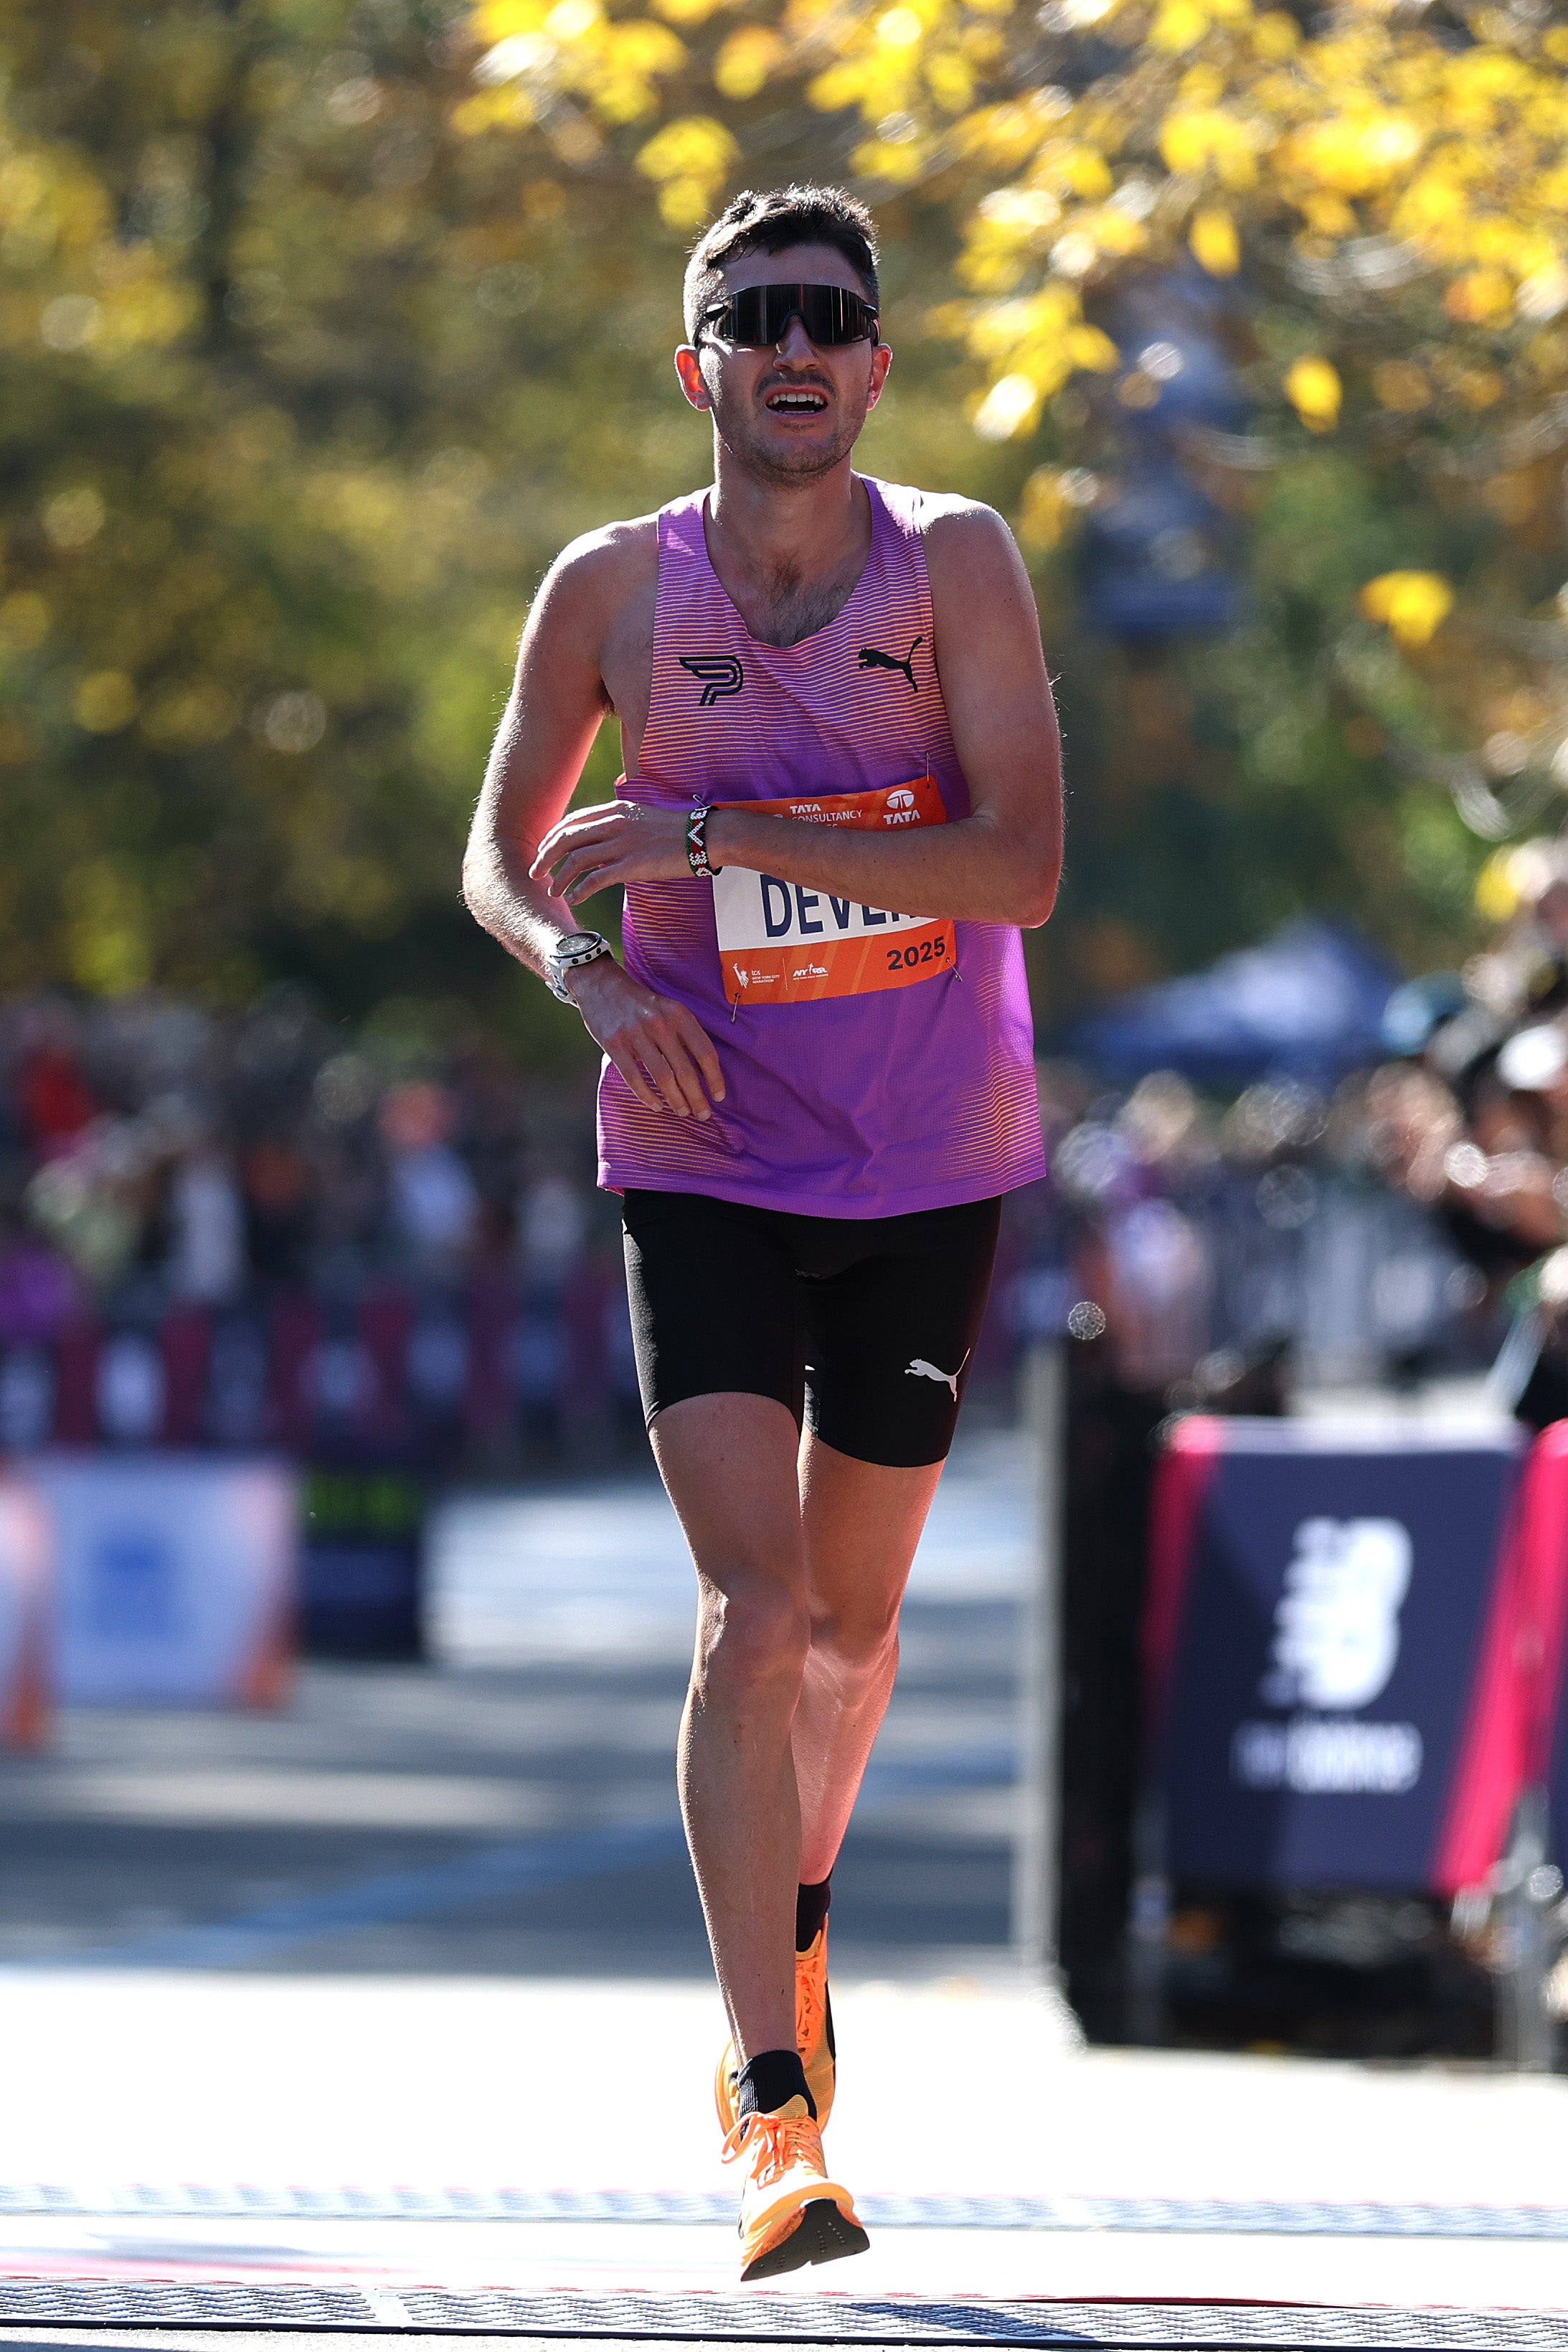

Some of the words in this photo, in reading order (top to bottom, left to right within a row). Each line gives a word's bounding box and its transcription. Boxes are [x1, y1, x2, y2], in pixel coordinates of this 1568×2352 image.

[790, 804, 821, 814] TATA
[883, 809, 921, 825] TATA
[760, 873, 917, 938] DEV
[887, 936, 946, 970] 2025
